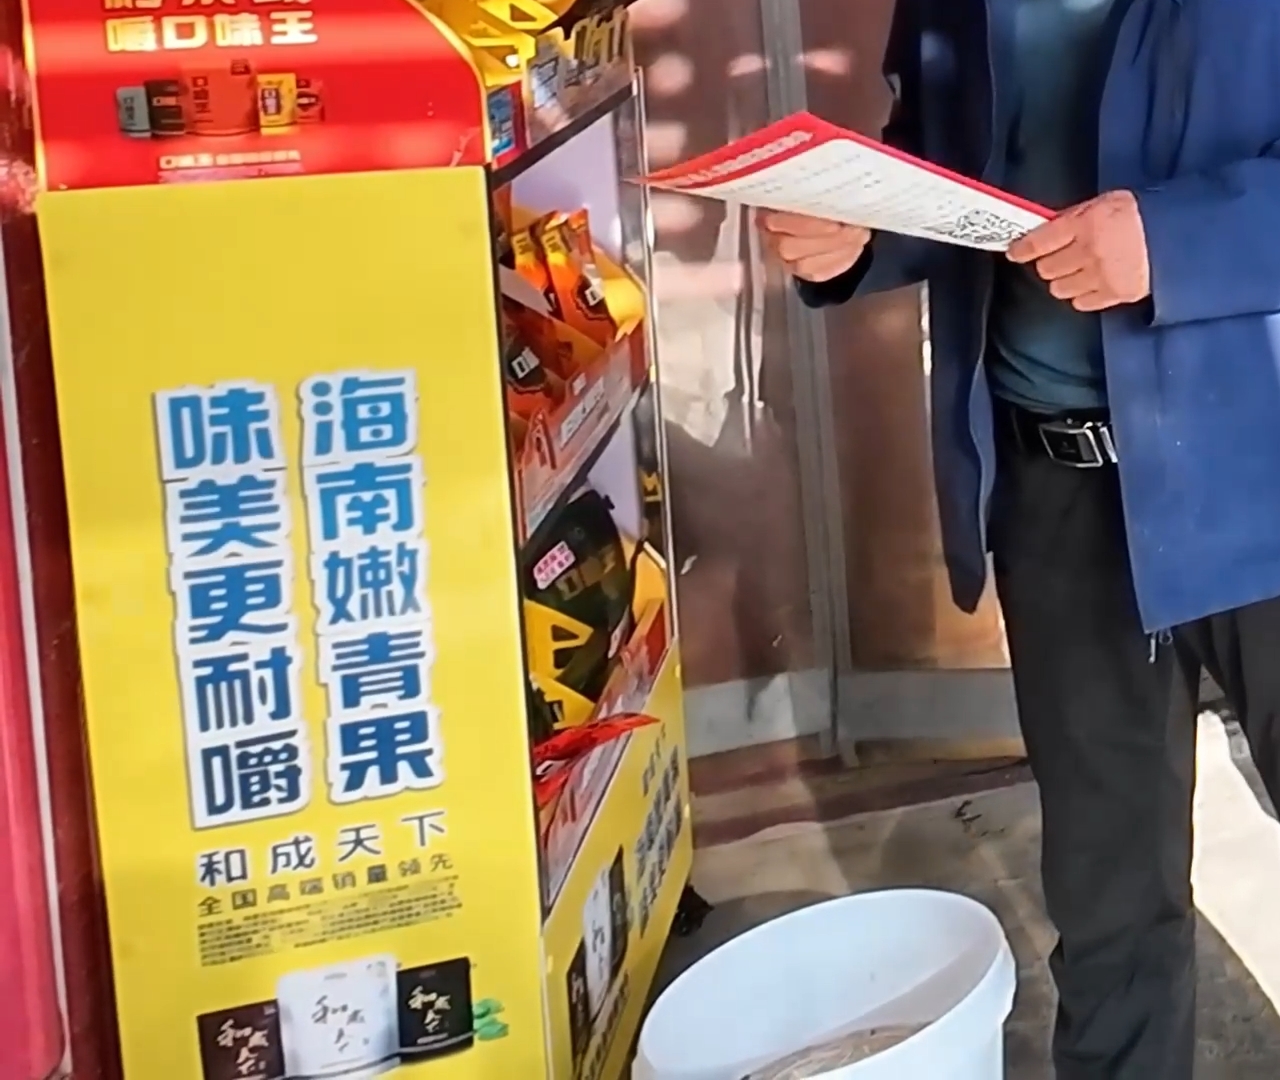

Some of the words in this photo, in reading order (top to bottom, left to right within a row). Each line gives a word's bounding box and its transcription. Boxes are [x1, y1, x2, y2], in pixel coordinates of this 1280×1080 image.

[168, 387, 302, 817] 味美更耐嚼
[311, 376, 435, 793] 海南嫩青果
[197, 853, 454, 918] 全国高端销量领先
[199, 810, 446, 888] 和成天下
